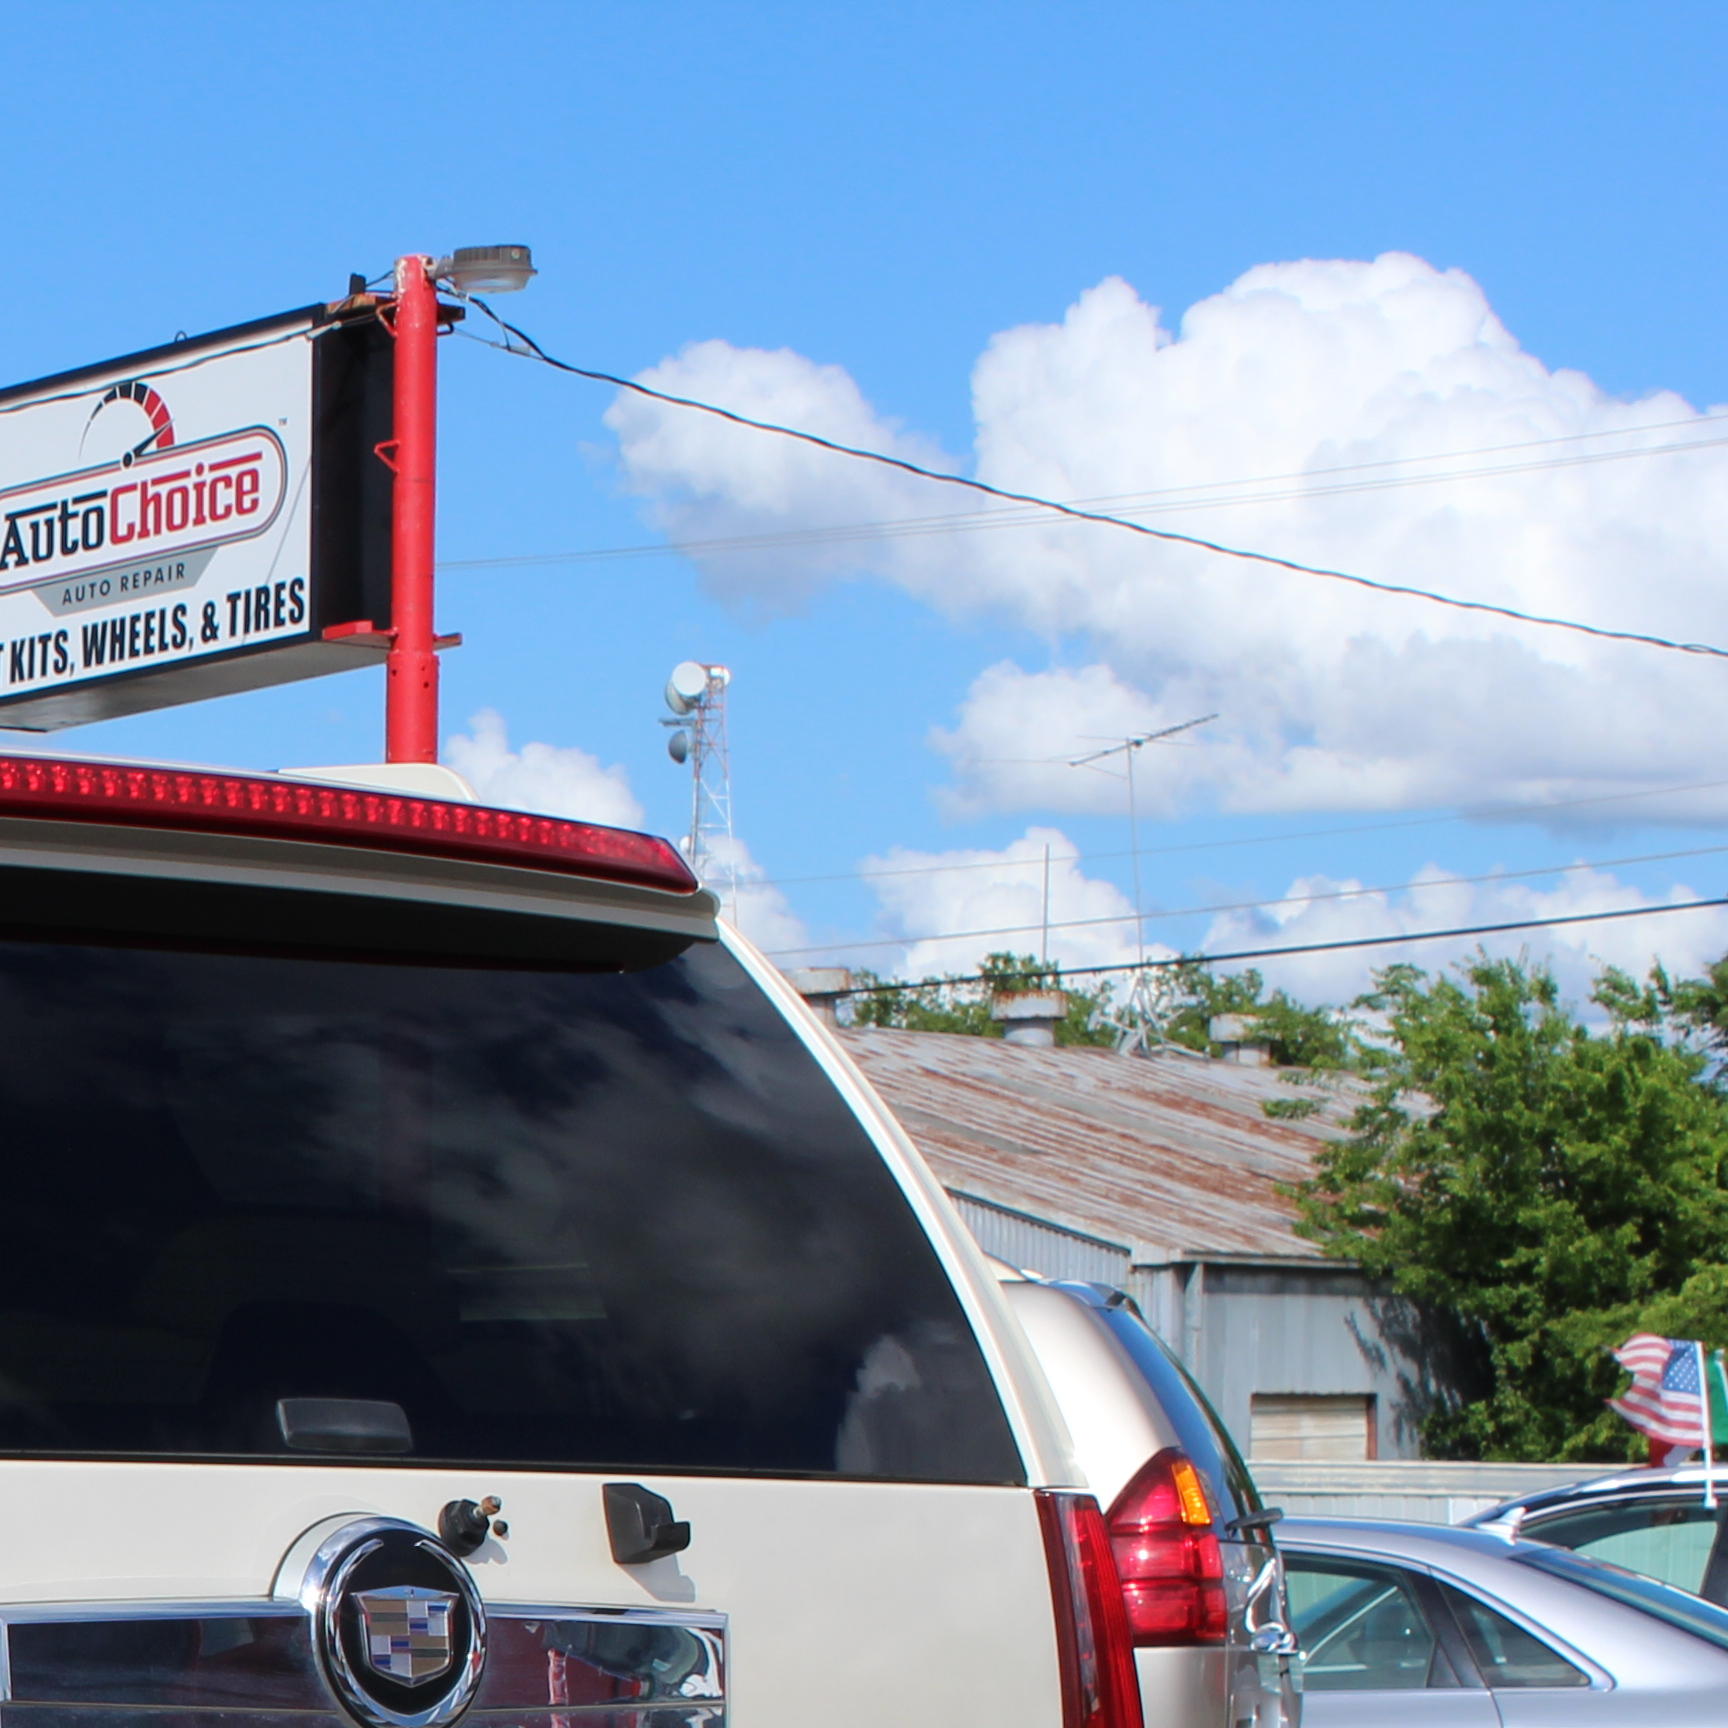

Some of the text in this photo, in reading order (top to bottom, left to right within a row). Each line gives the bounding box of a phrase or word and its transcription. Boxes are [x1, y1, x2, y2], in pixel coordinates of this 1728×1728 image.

[61, 562, 186, 606] AUTO REPAIR
[9, 629, 75, 685] KITS,
[82, 602, 194, 668] WHEELS,
[200, 599, 220, 643] &
[226, 577, 306, 638] TIRES
